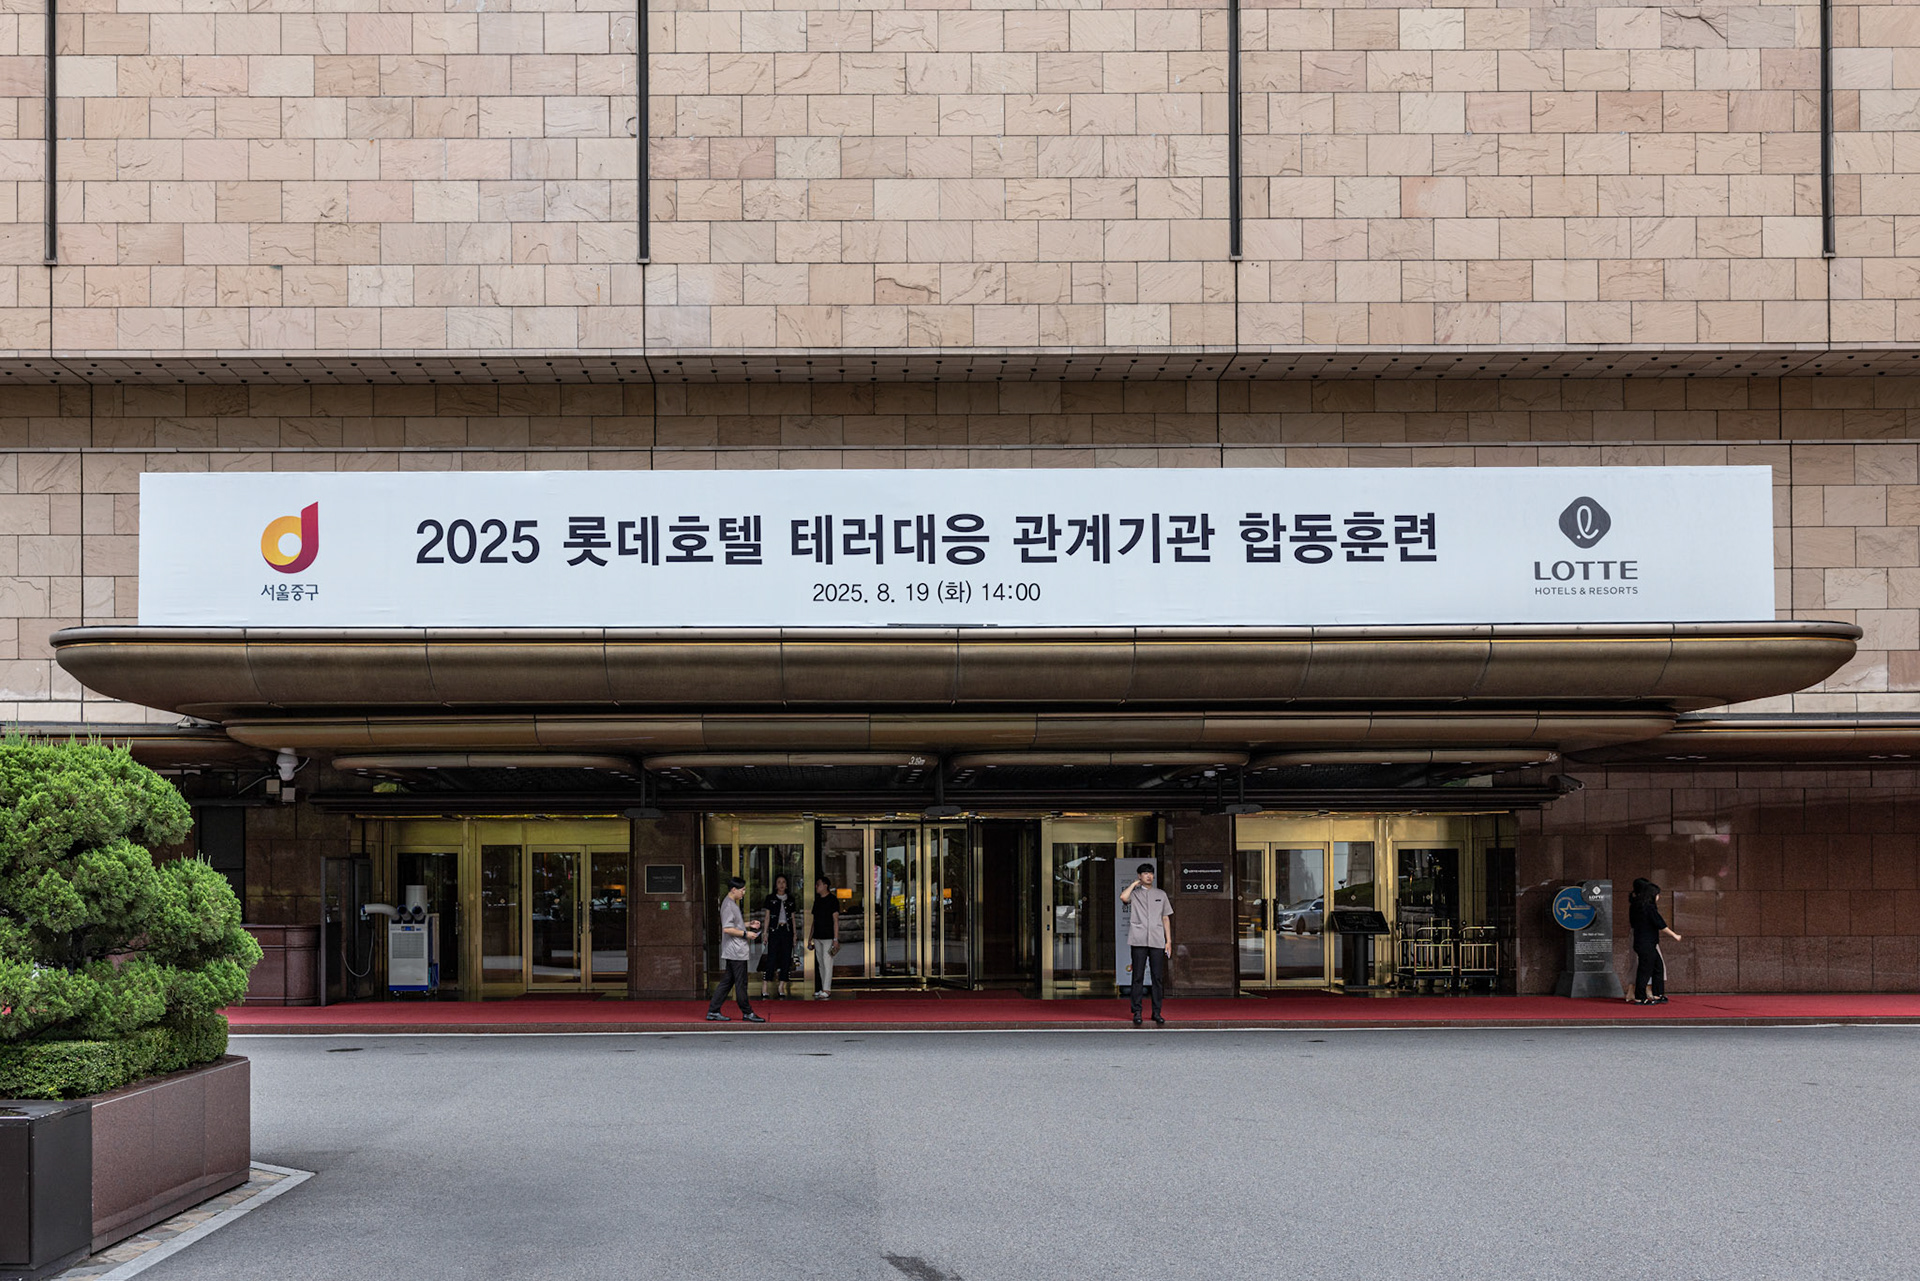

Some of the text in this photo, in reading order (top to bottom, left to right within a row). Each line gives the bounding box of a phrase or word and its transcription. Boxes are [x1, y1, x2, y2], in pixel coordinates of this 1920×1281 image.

[417, 511, 1437, 566] 2025 롯데호텔 테러대응 관계기관 합동훈련
[1535, 561, 1638, 581] LOTTE
[261, 584, 319, 601] 서울중구
[813, 580, 1041, 604] 2025. 8. 19 (화) 14:00
[1535, 586, 1638, 595] HOTELS & RESORTS
